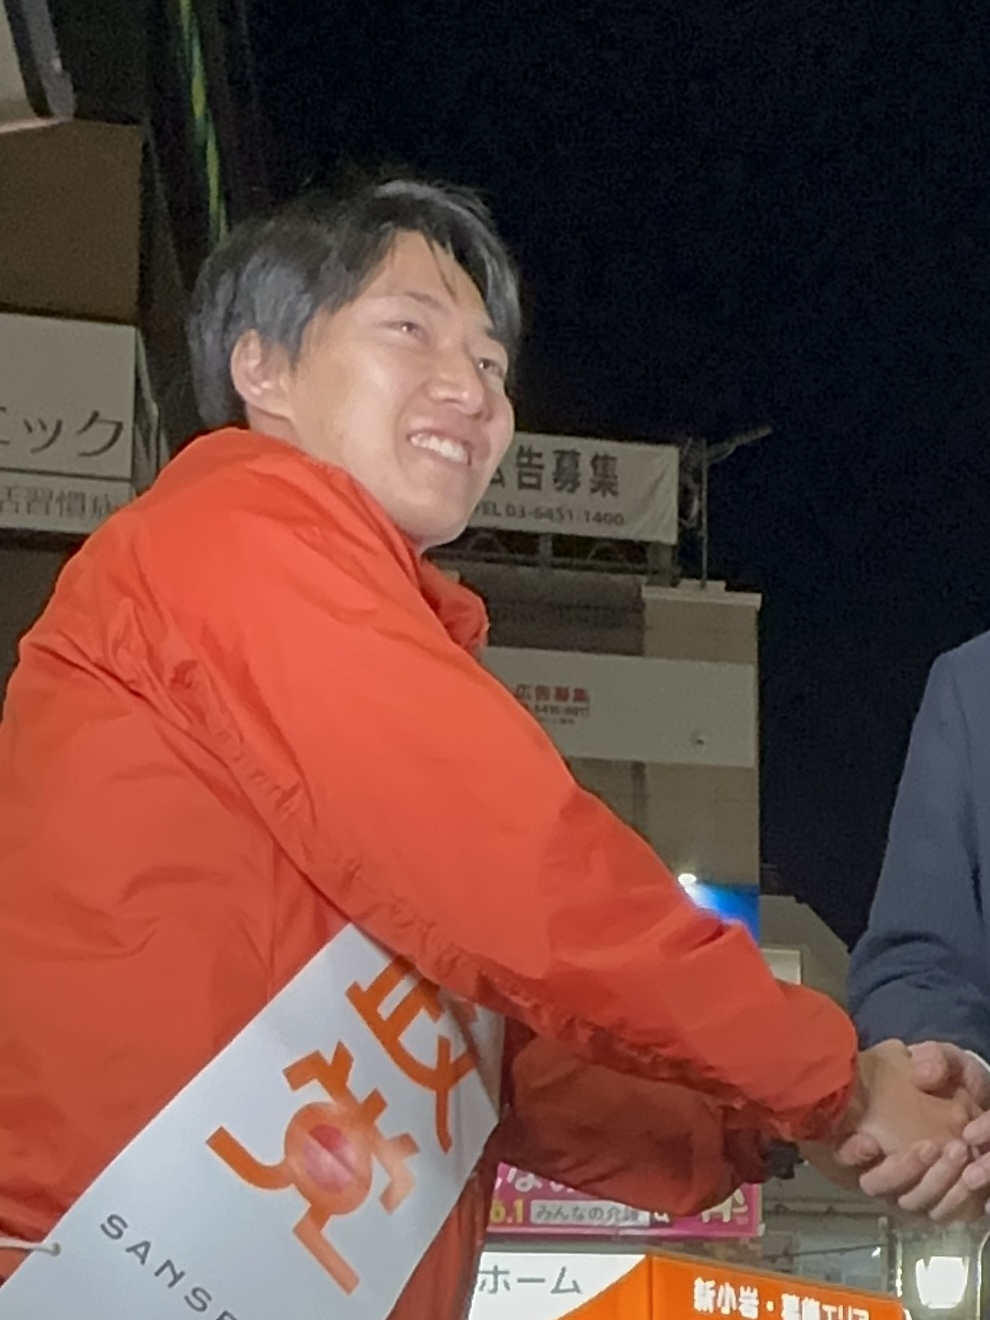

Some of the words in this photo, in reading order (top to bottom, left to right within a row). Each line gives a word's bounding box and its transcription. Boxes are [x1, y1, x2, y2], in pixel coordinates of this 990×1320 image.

[0, 405, 124, 457] ック
[478, 1264, 583, 1295] ホーム
